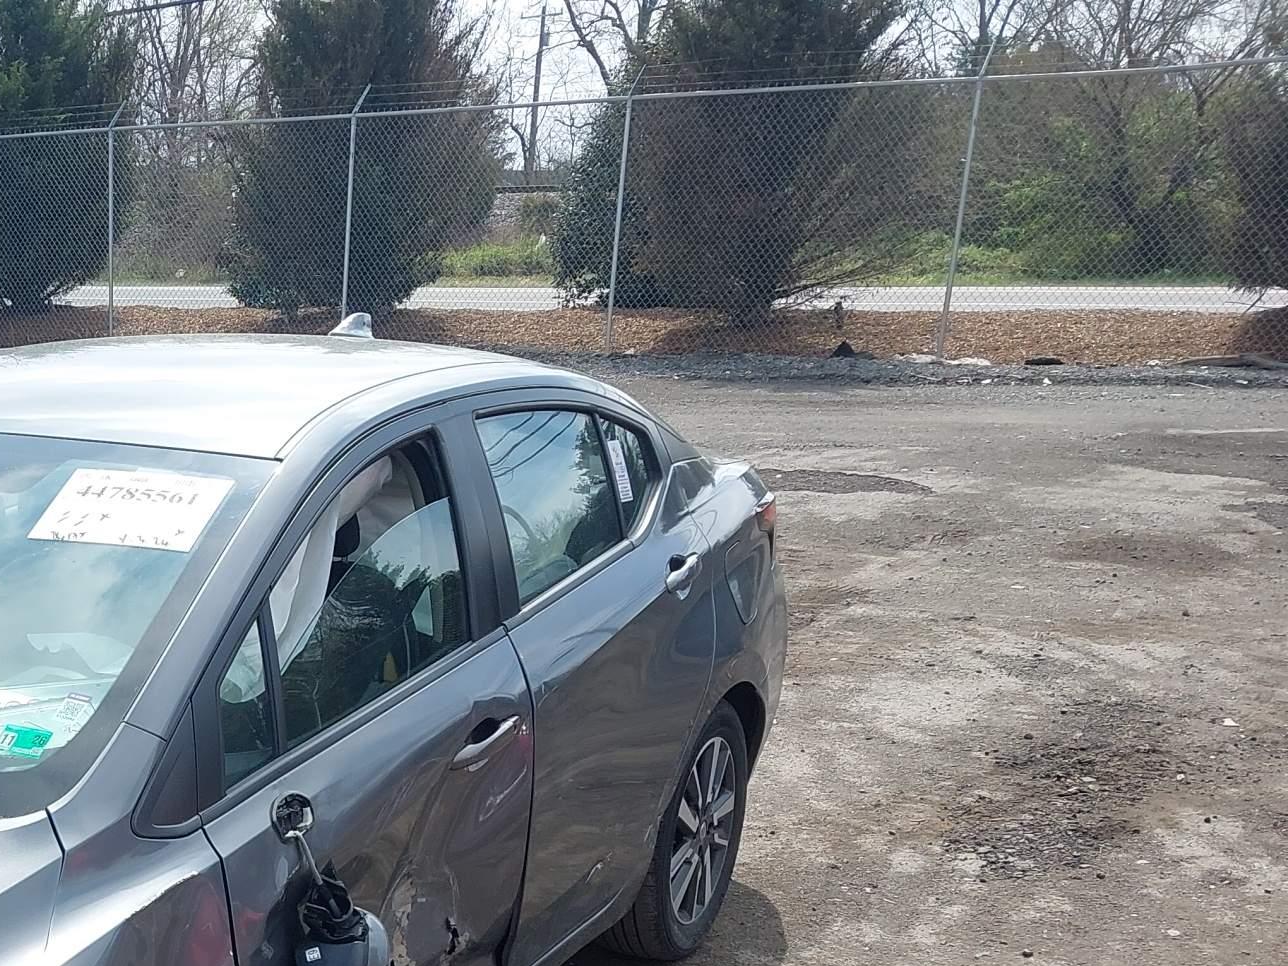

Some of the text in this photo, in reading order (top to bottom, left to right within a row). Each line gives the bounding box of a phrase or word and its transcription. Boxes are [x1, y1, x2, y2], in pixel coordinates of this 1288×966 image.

[77, 485, 199, 505] 44785561
[1, 733, 48, 746] 11 26
